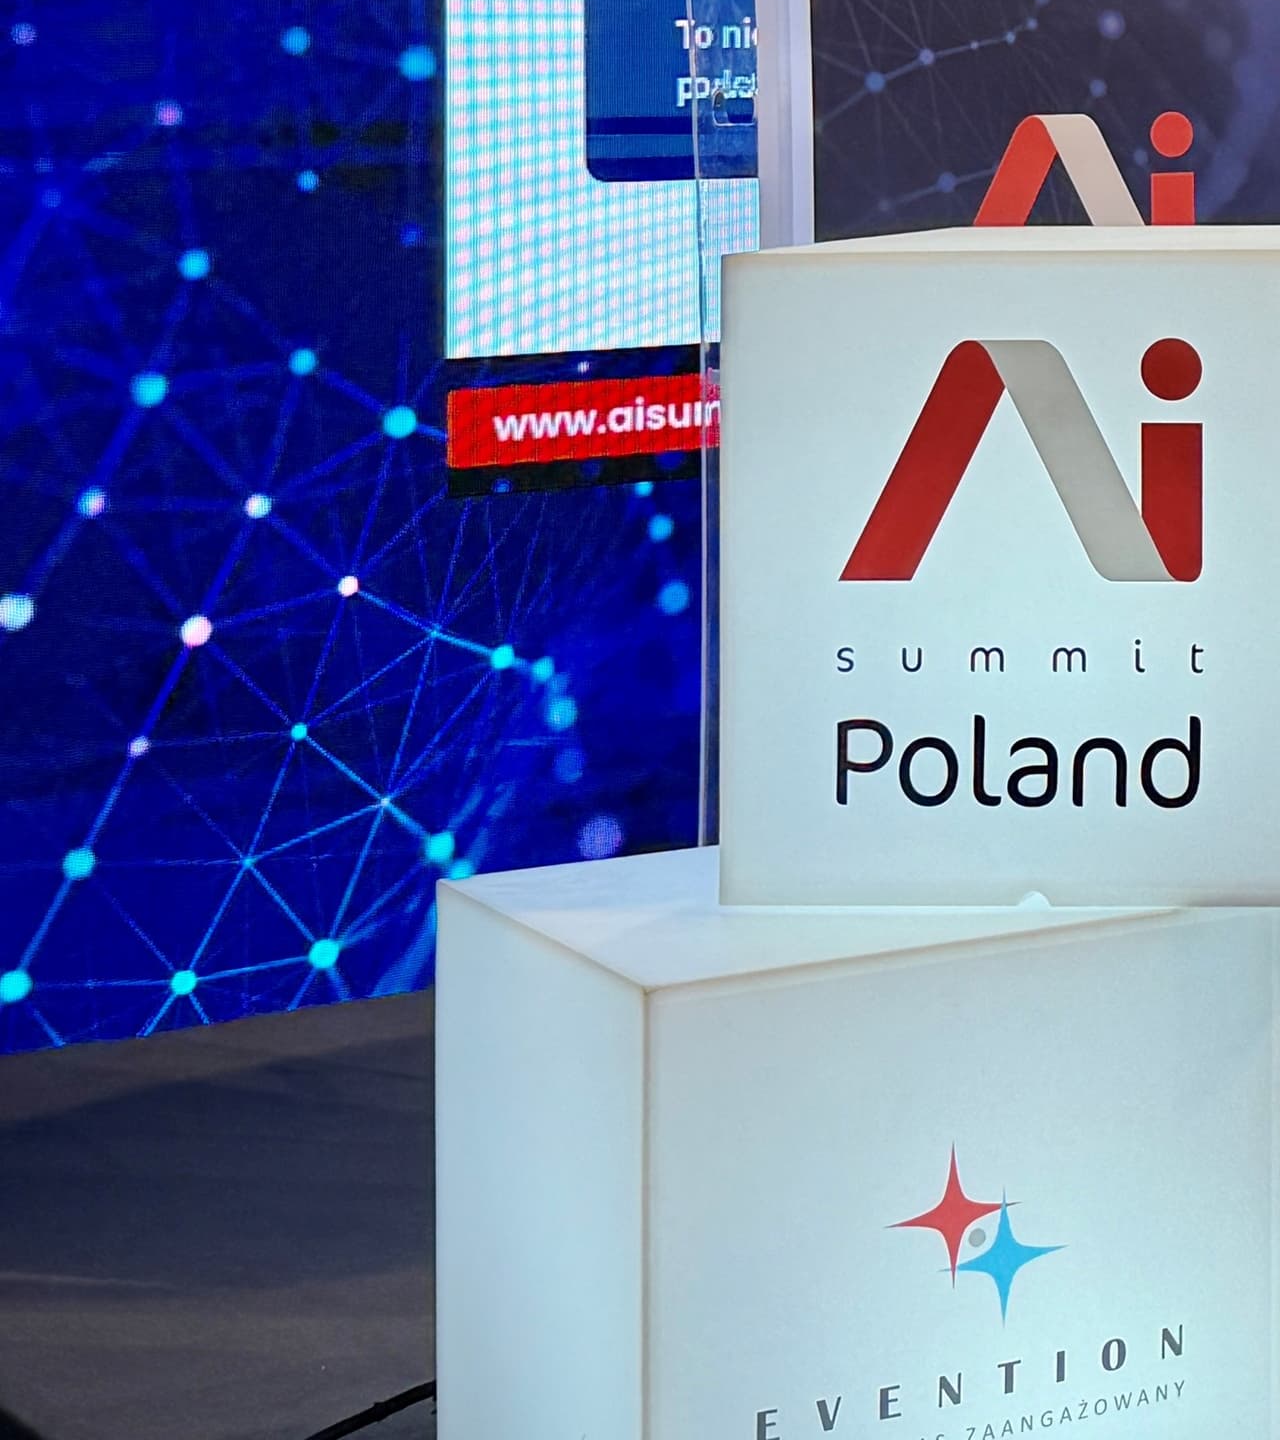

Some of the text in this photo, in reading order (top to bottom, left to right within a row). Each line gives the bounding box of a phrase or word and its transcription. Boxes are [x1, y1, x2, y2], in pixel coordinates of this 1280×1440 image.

[675, 19, 714, 50] To
[493, 396, 720, 442] www.aisum
[836, 639, 1204, 674] summit
[836, 714, 1202, 809] Poland
[756, 1324, 1184, 1440] EVENTION
